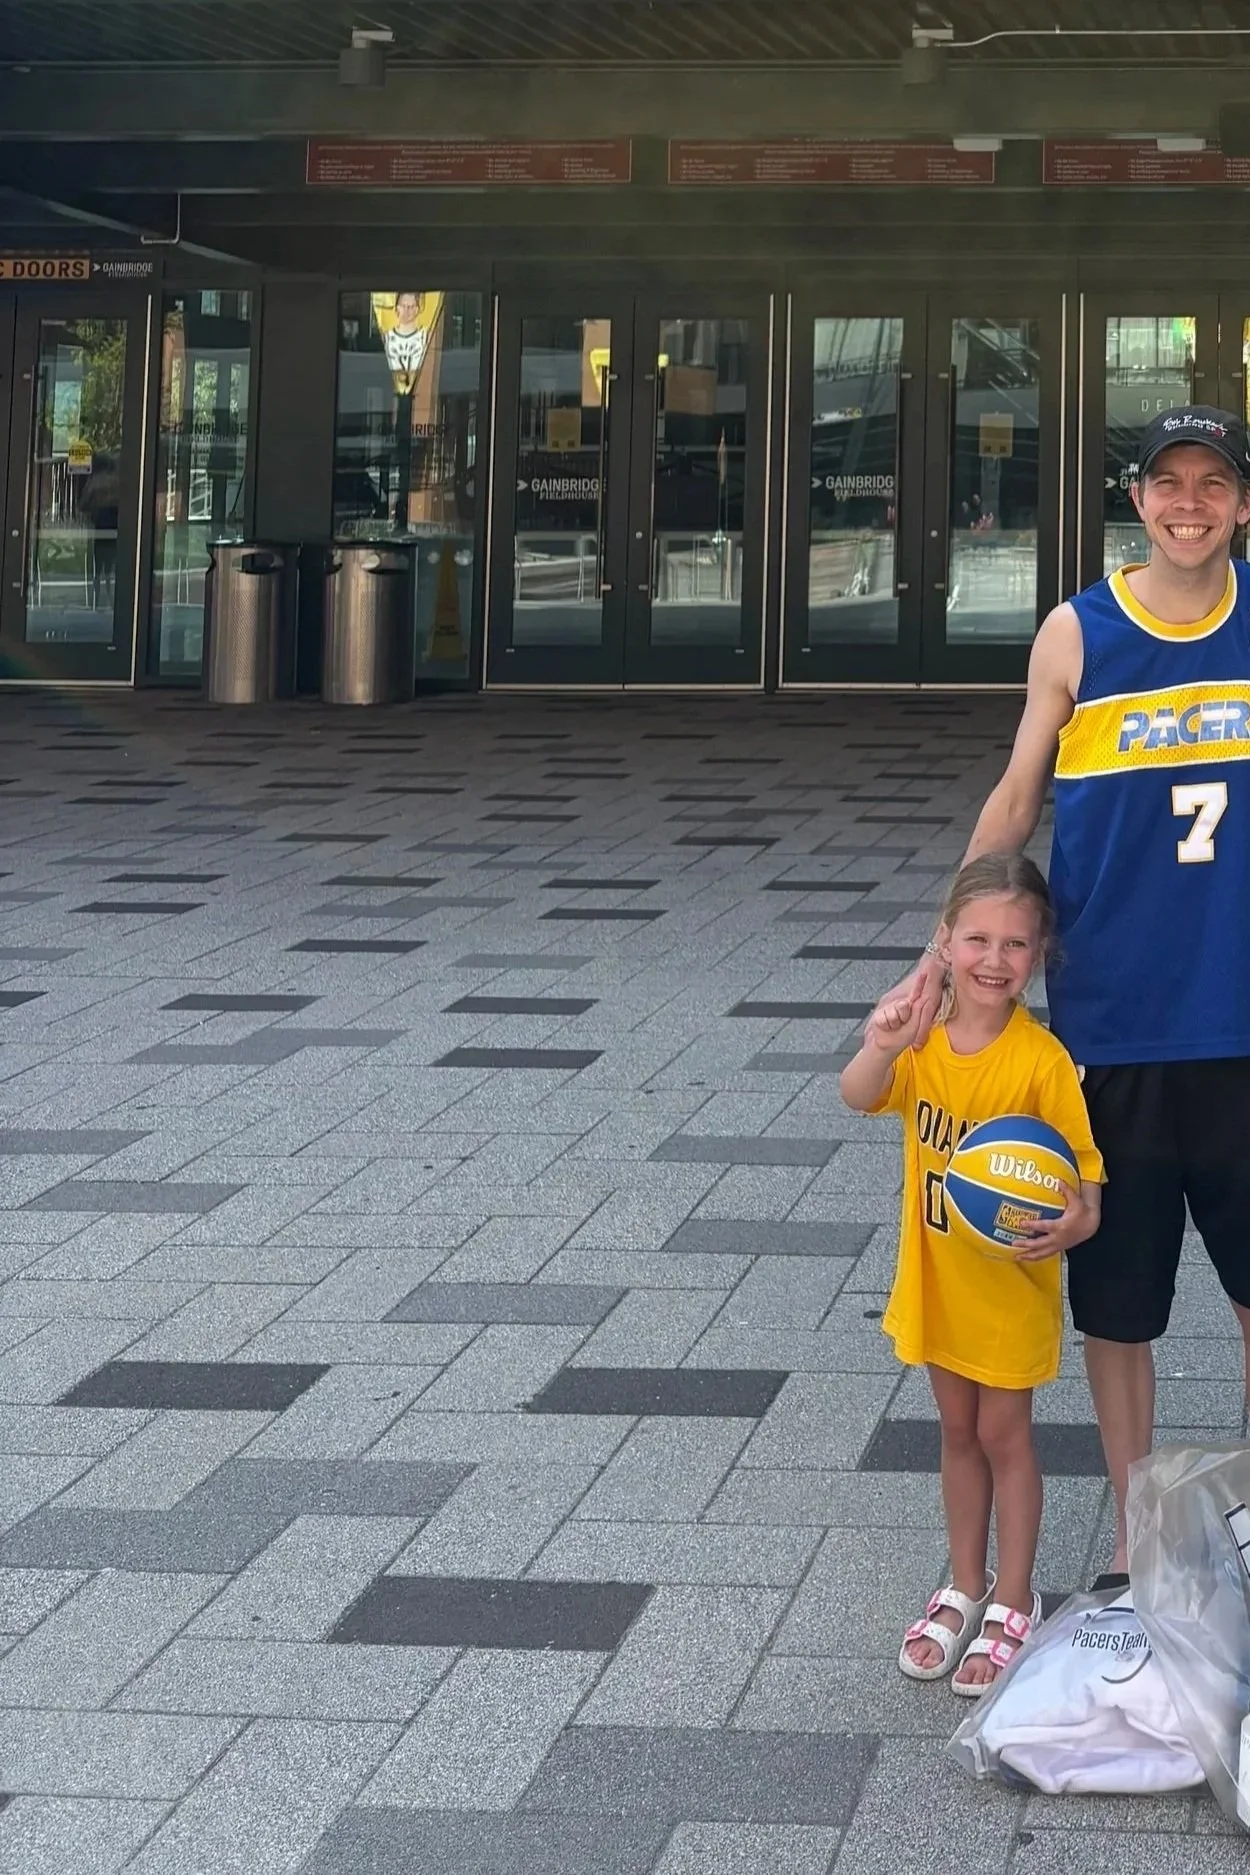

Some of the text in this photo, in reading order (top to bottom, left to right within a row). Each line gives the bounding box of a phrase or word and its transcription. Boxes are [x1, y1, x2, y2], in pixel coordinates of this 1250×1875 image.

[13, 261, 85, 277] DOORS
[530, 477, 606, 492] GAINBRIDG
[825, 475, 895, 489] GAINBRIDG
[1171, 782, 1229, 864] 7
